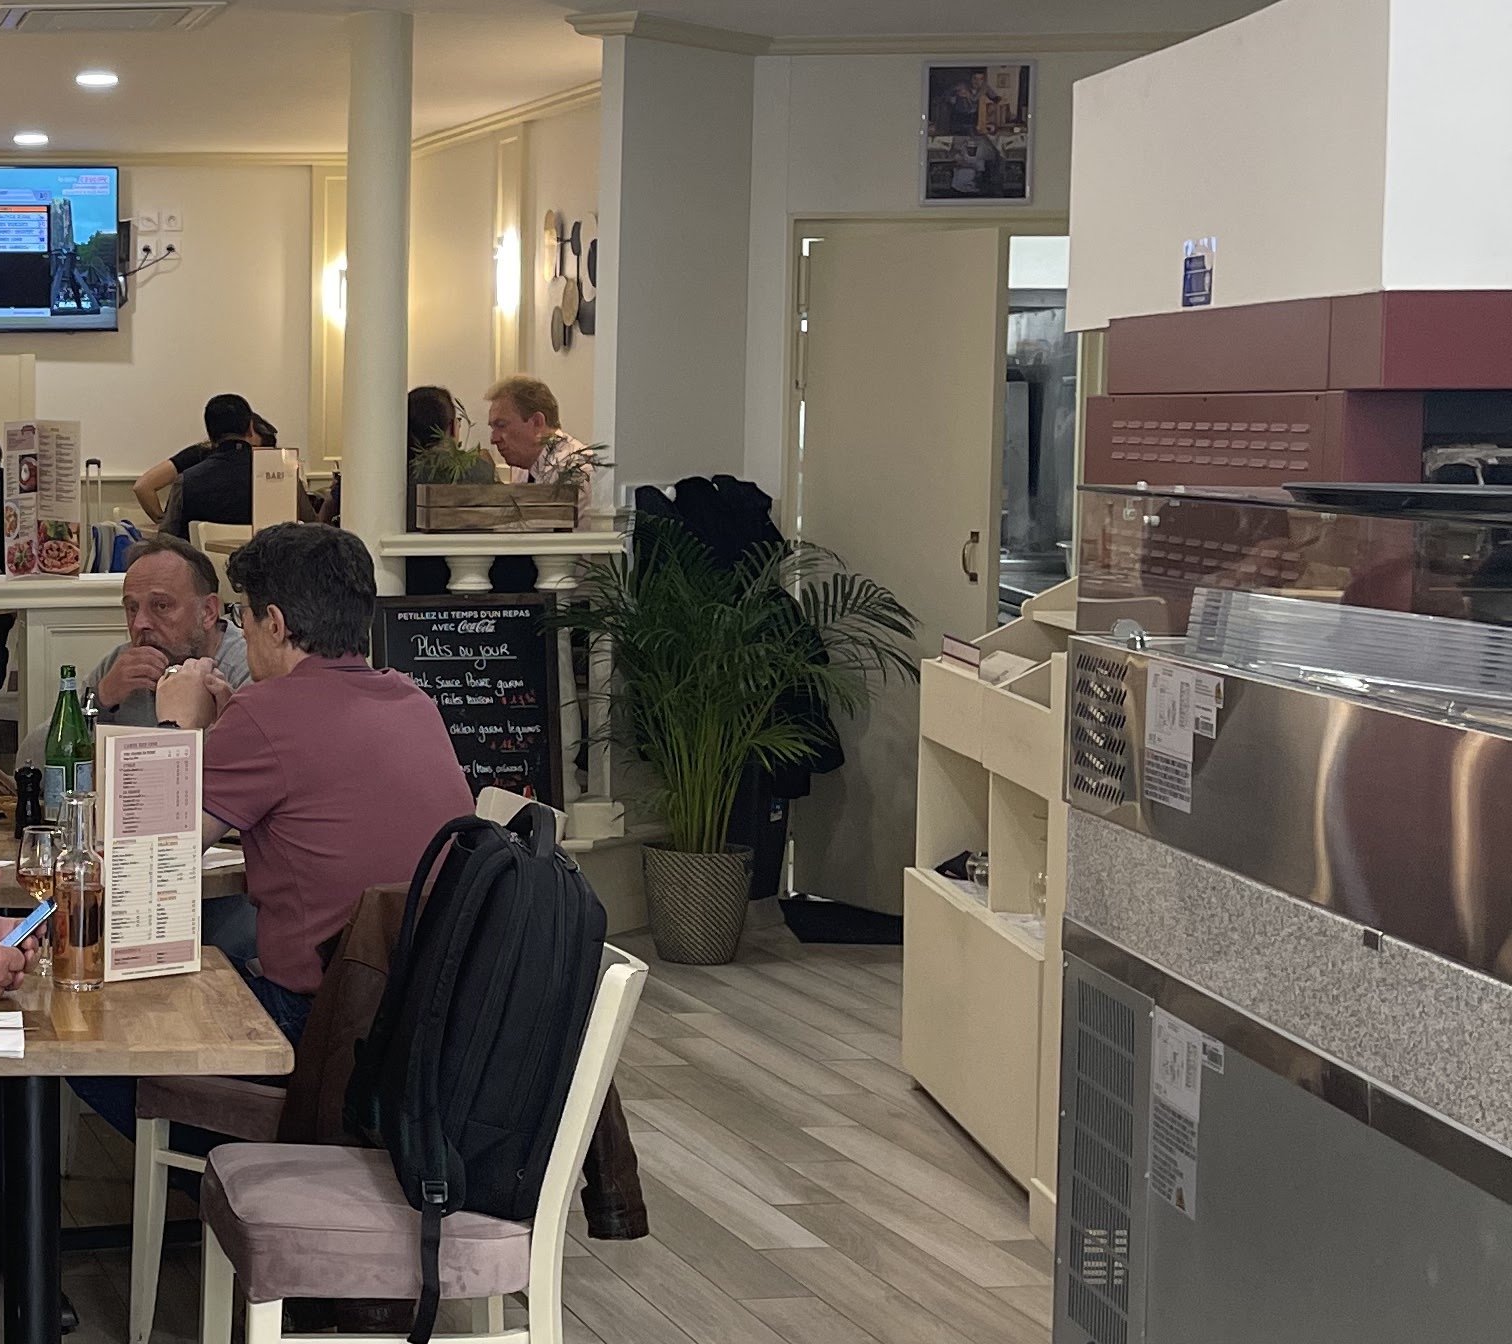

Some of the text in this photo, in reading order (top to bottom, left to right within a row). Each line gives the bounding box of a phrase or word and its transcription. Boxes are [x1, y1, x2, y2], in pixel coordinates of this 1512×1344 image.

[265, 471, 285, 480] BARI
[397, 609, 531, 621] PETILLEZ LE TEMPS D'UN REPAS
[431, 623, 456, 632] AVEC
[410, 634, 453, 657] Plats
